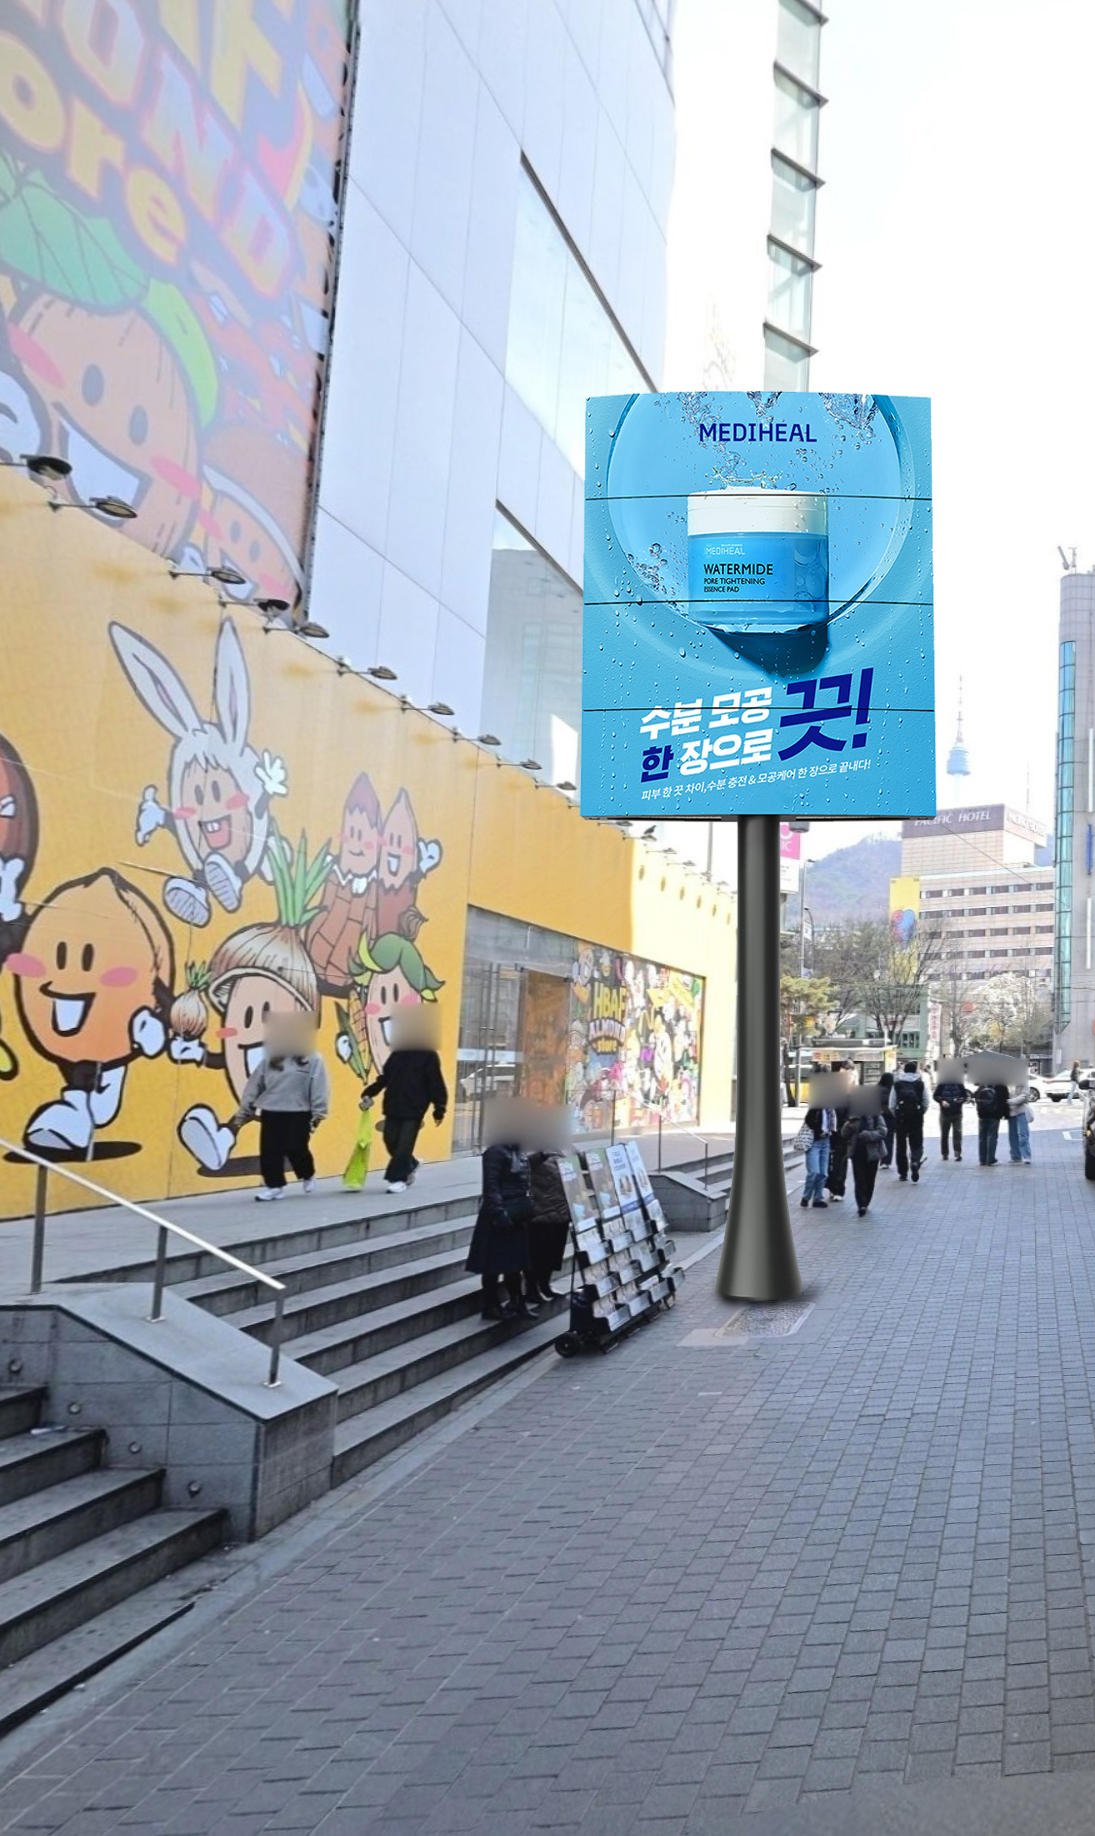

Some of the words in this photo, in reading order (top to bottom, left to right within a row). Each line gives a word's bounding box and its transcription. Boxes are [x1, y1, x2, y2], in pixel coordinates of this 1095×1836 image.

[700, 423, 817, 442] MEDIHEAL
[703, 564, 773, 575] WATERMIDE
[704, 547, 745, 555] MEDIHEAL
[639, 698, 703, 740] 수분
[708, 686, 773, 729] 모공
[777, 667, 874, 761] 끗!
[641, 745, 675, 783] 한
[680, 728, 773, 776] 장으로
[641, 788, 661, 801] 피부
[662, 786, 673, 798] 한
[798, 767, 808, 779] 한
[809, 763, 838, 777] 장으로
[839, 759, 872, 773] 끝내다!
[958, 811, 991, 823] HOTEL
[593, 981, 627, 1021] HBAF
